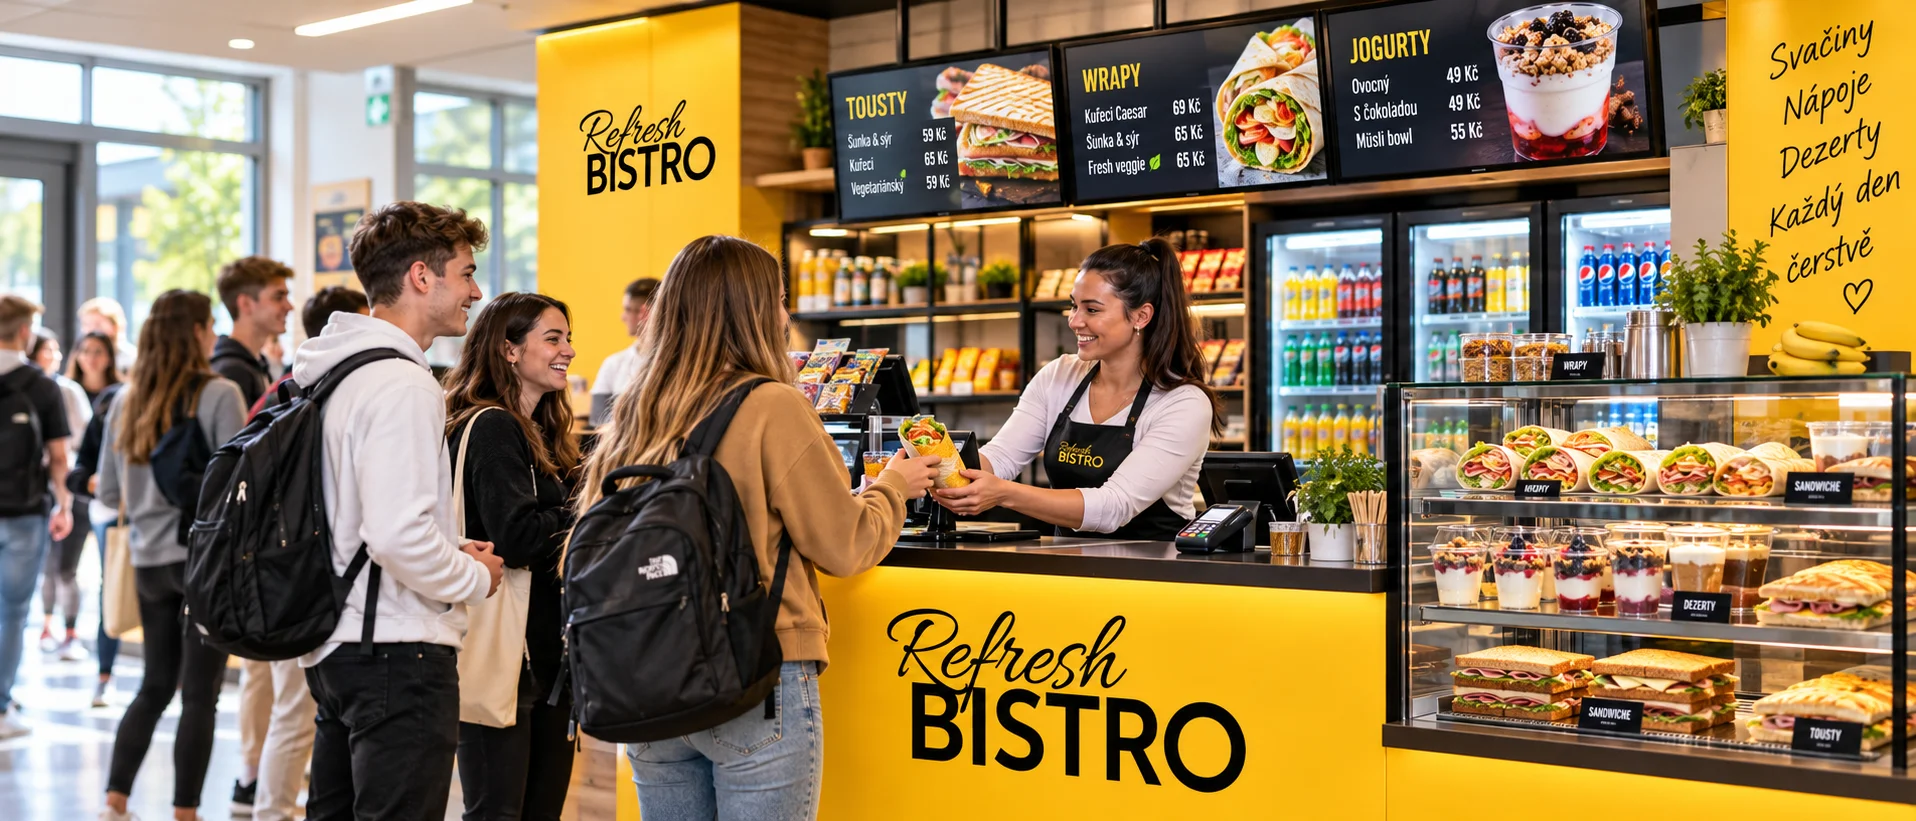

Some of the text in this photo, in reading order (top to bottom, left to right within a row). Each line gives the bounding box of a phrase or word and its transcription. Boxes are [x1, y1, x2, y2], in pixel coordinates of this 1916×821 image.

[1350, 29, 1430, 64] JOGURTY
[1770, 20, 1874, 80] Svačiny
[1082, 63, 1141, 93] WRAPY
[1352, 64, 1478, 94] Ovocný 49 Kč
[846, 90, 907, 120] TOUSTY
[1116, 106, 1147, 120] Caesar
[1172, 100, 1185, 116] 69
[1188, 97, 1201, 113] Kč
[1354, 105, 1361, 122] S
[1448, 95, 1463, 112] 49
[1467, 93, 1481, 110] Kč
[1784, 71, 1872, 125] Nápoje
[579, 99, 687, 159] Refresh
[848, 127, 947, 149] Šunka & sýr 59 Kč
[1116, 132, 1124, 147] &
[1126, 130, 1140, 149] sýr
[1174, 126, 1187, 141] 65
[1190, 124, 1203, 140] Kč
[1356, 122, 1483, 149] Müsli bowl 55 Kč
[924, 152, 936, 166] 65
[937, 150, 948, 165] Kč
[1780, 118, 1881, 178] Dezerty
[587, 136, 716, 196] BISTRO
[1088, 151, 1205, 175] Fresh veggie 65 Kč
[926, 175, 938, 190] 59
[940, 174, 950, 188] Kč
[1770, 169, 1900, 238] Každý den
[1787, 227, 1874, 283] čerstvě
[1563, 360, 1588, 370] WRAPY
[1058, 451, 1104, 468] BISTRO
[1794, 480, 1841, 492] SANDWICHE
[1683, 599, 1716, 611] DEZERTY
[886, 608, 1128, 713] Refresh
[1588, 706, 1631, 720] SANDWICHE
[912, 682, 1246, 793] BISTRO
[1810, 727, 1842, 741] TOUSTY
